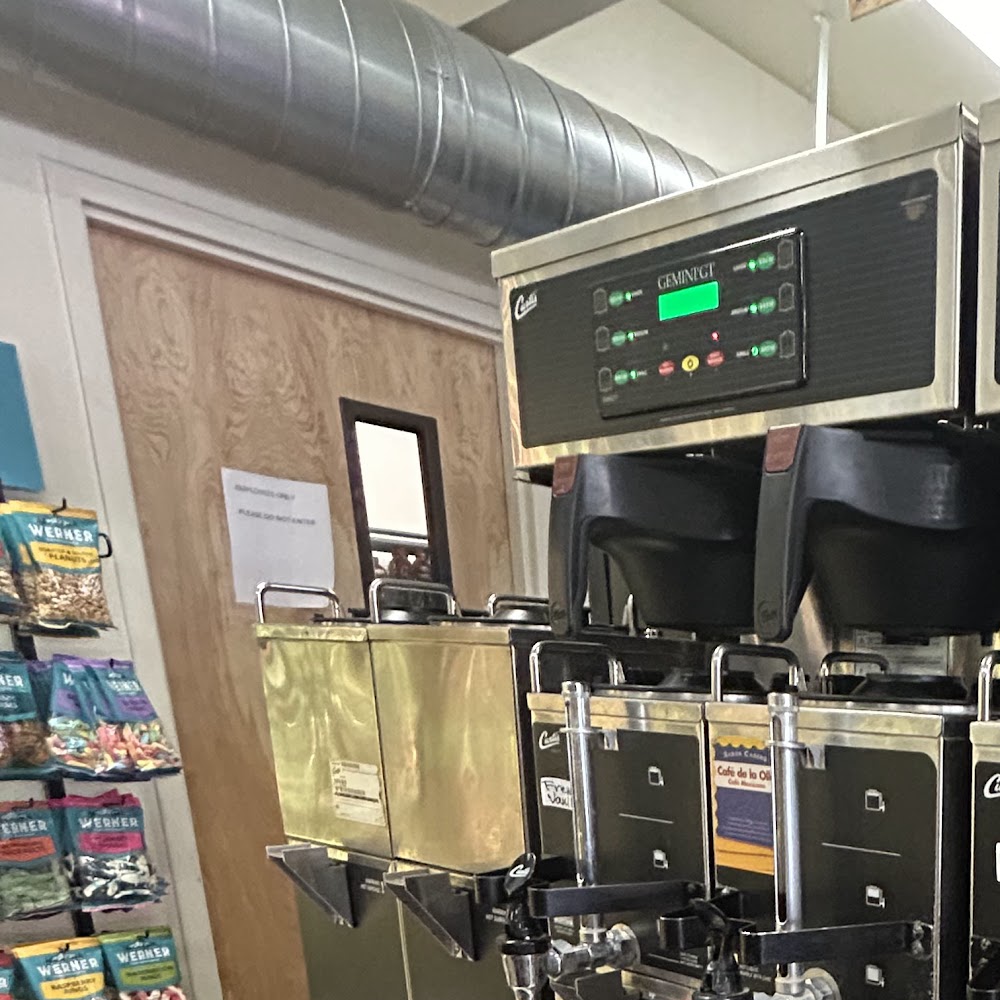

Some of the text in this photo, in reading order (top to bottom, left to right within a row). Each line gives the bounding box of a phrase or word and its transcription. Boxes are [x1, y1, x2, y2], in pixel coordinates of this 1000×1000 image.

[28, 523, 93, 542] WERNER
[749, 768, 758, 780] la
[0, 820, 47, 834] ERNER
[79, 817, 139, 828] WERNER
[116, 946, 171, 963] WERNER
[37, 957, 100, 977] WERNER
